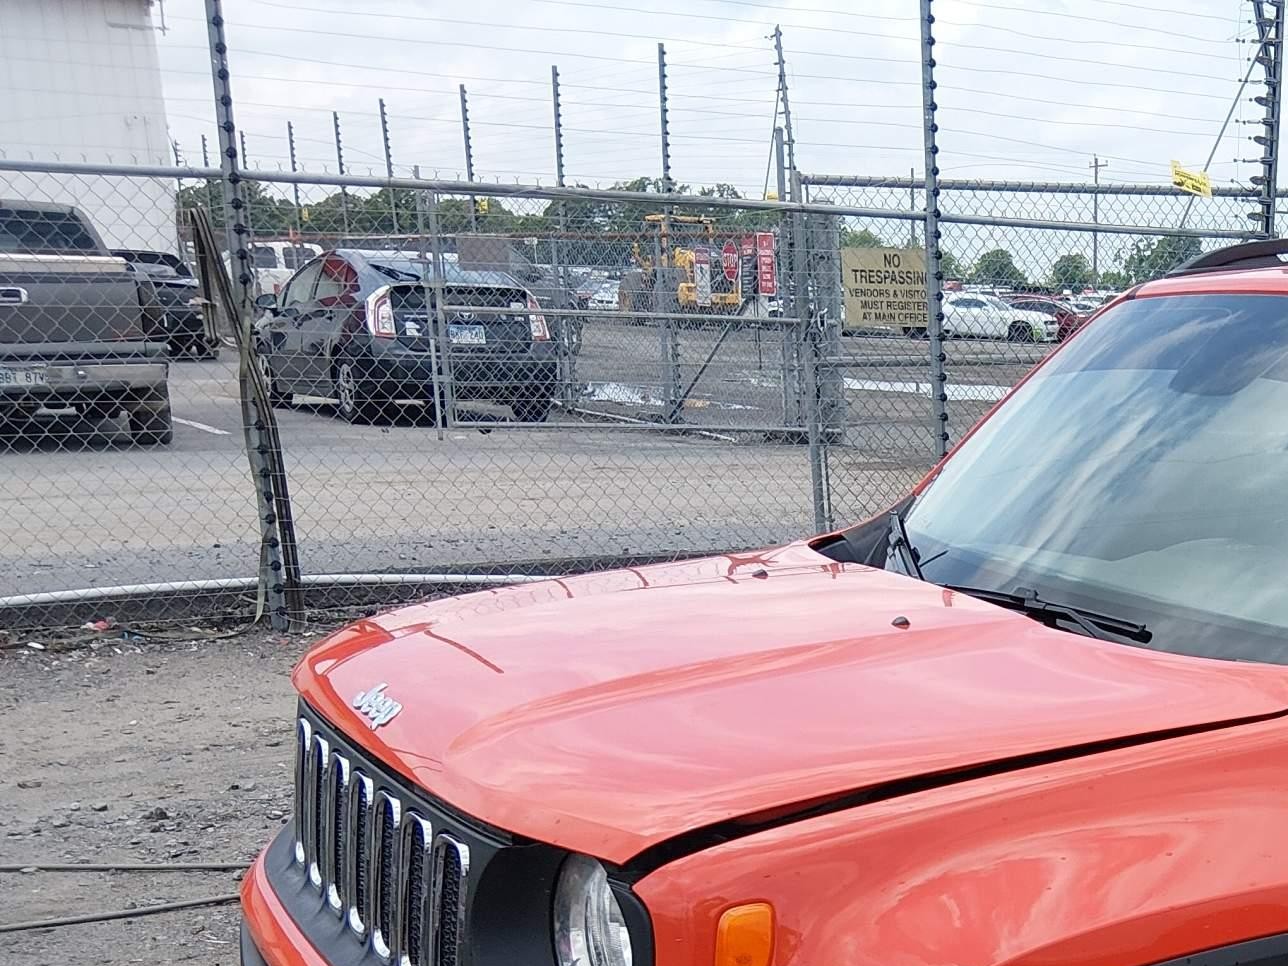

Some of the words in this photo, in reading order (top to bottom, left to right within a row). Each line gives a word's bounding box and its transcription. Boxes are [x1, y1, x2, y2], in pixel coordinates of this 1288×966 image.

[723, 252, 737, 268] STOP
[883, 254, 901, 268] NO
[852, 268, 927, 285] TRESPASSIN
[849, 288, 891, 298] VENDORS
[893, 289, 899, 298] &
[900, 289, 927, 300] VISITO
[860, 300, 884, 310] MUST
[886, 301, 928, 312] REGISTER
[862, 312, 872, 320] AT
[874, 312, 896, 321] MAIN
[898, 312, 928, 322] OFFICE
[352, 682, 403, 731] Jeep
